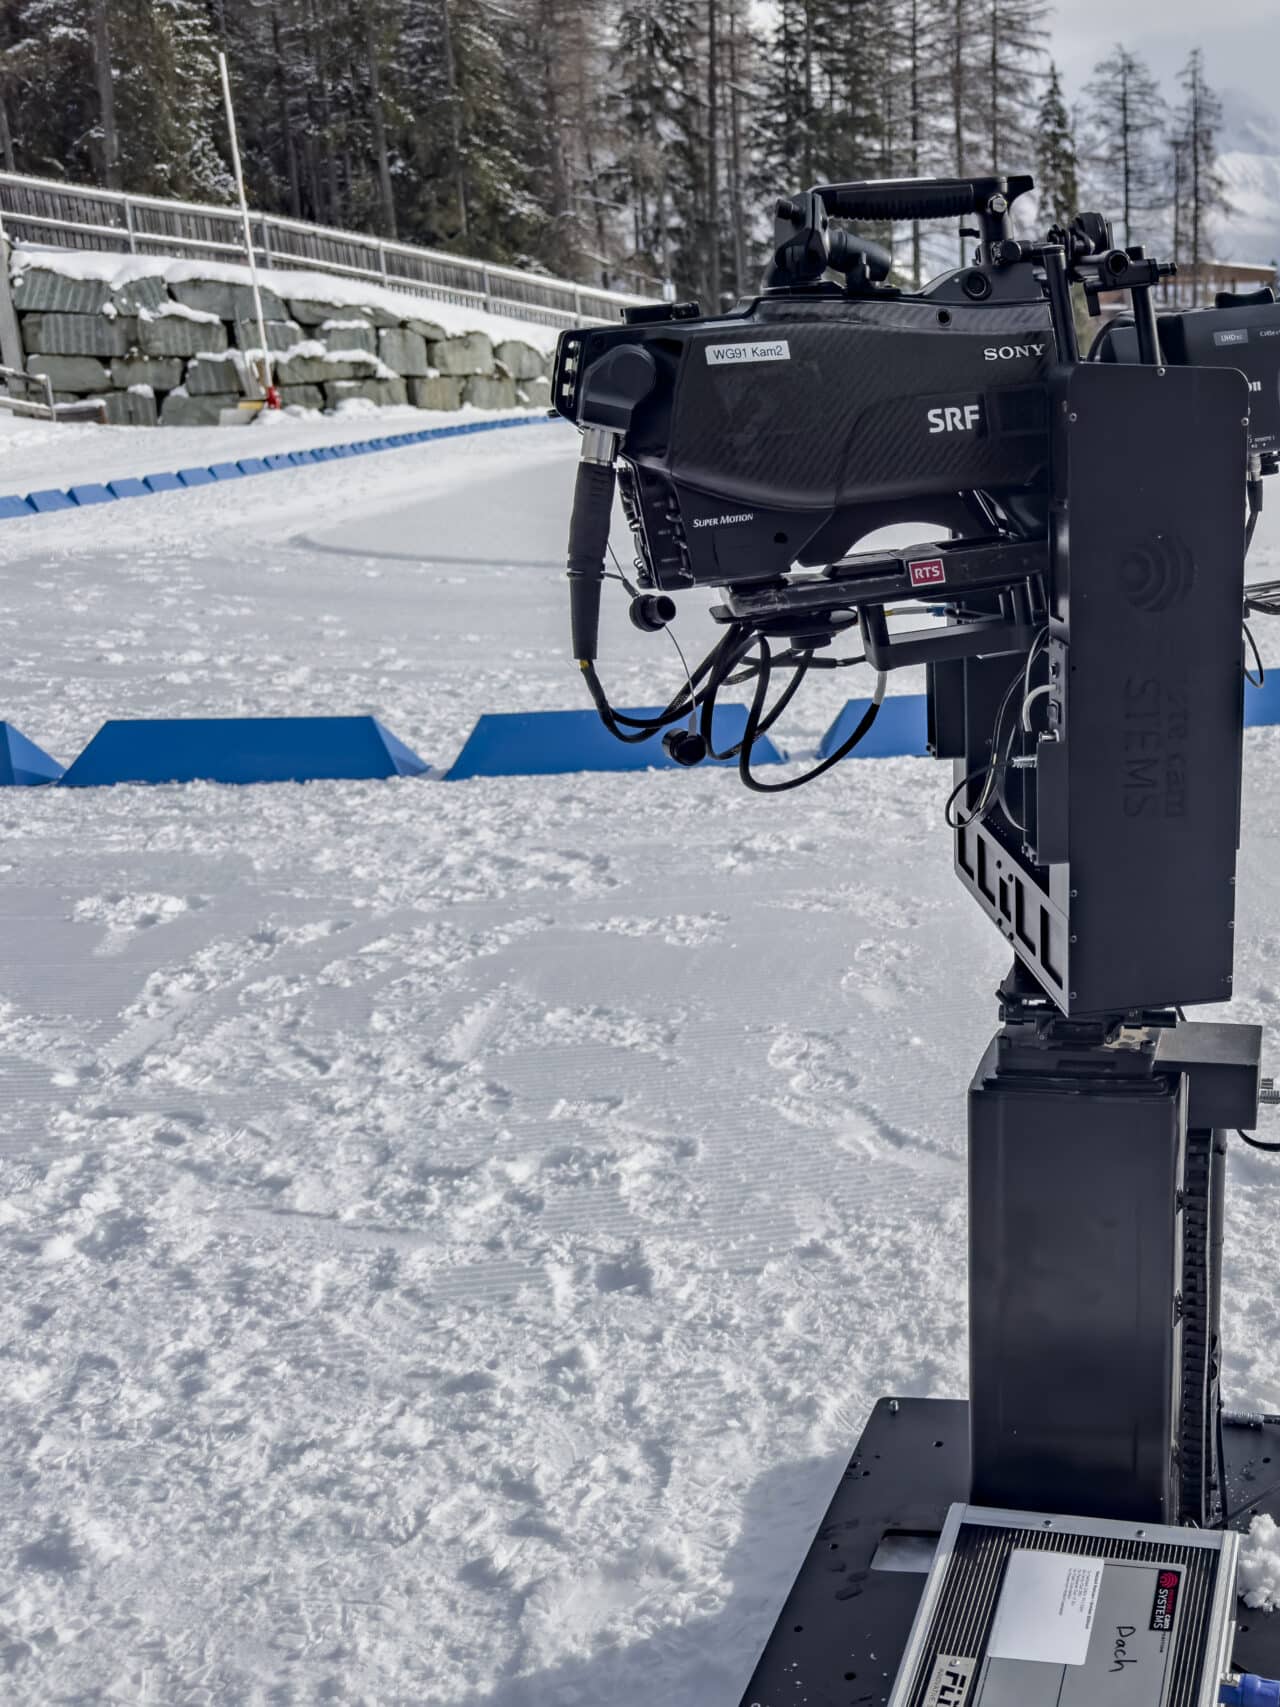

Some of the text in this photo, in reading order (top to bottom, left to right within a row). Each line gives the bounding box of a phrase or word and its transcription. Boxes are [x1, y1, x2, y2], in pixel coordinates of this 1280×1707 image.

[713, 344, 784, 360] WG91 Kam2
[983, 343, 1046, 361] SONY
[927, 404, 980, 434] SRF
[914, 565, 940, 579] RTS
[1153, 1588, 1169, 1629] SYSTEMS
[1108, 1625, 1138, 1673] Dach
